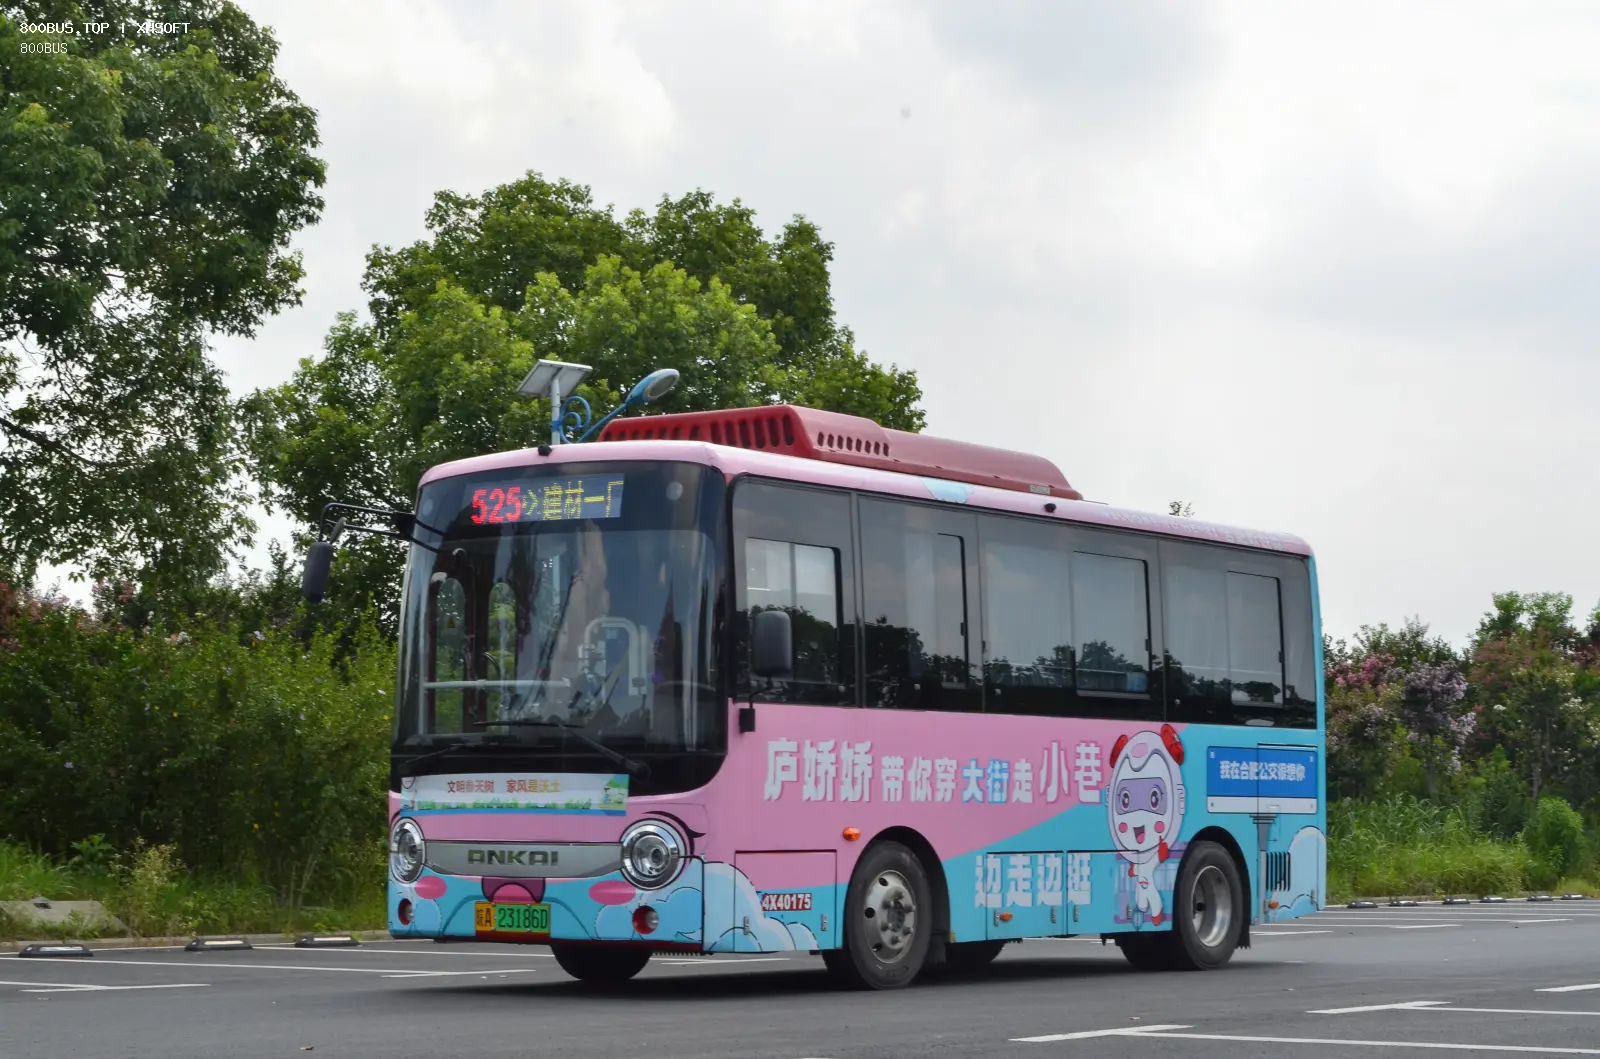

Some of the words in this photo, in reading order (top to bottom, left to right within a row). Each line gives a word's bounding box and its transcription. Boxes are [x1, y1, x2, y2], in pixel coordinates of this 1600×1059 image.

[470, 486, 522, 525] 525
[542, 479, 625, 521] 建材一厂
[764, 736, 1104, 804] 庐娇娇带你穿大街走小巷
[467, 849, 559, 867] ANKAI
[974, 852, 1093, 909] 边走边逛
[498, 907, 549, 930] 23186D
[761, 893, 812, 911] 4X40175
